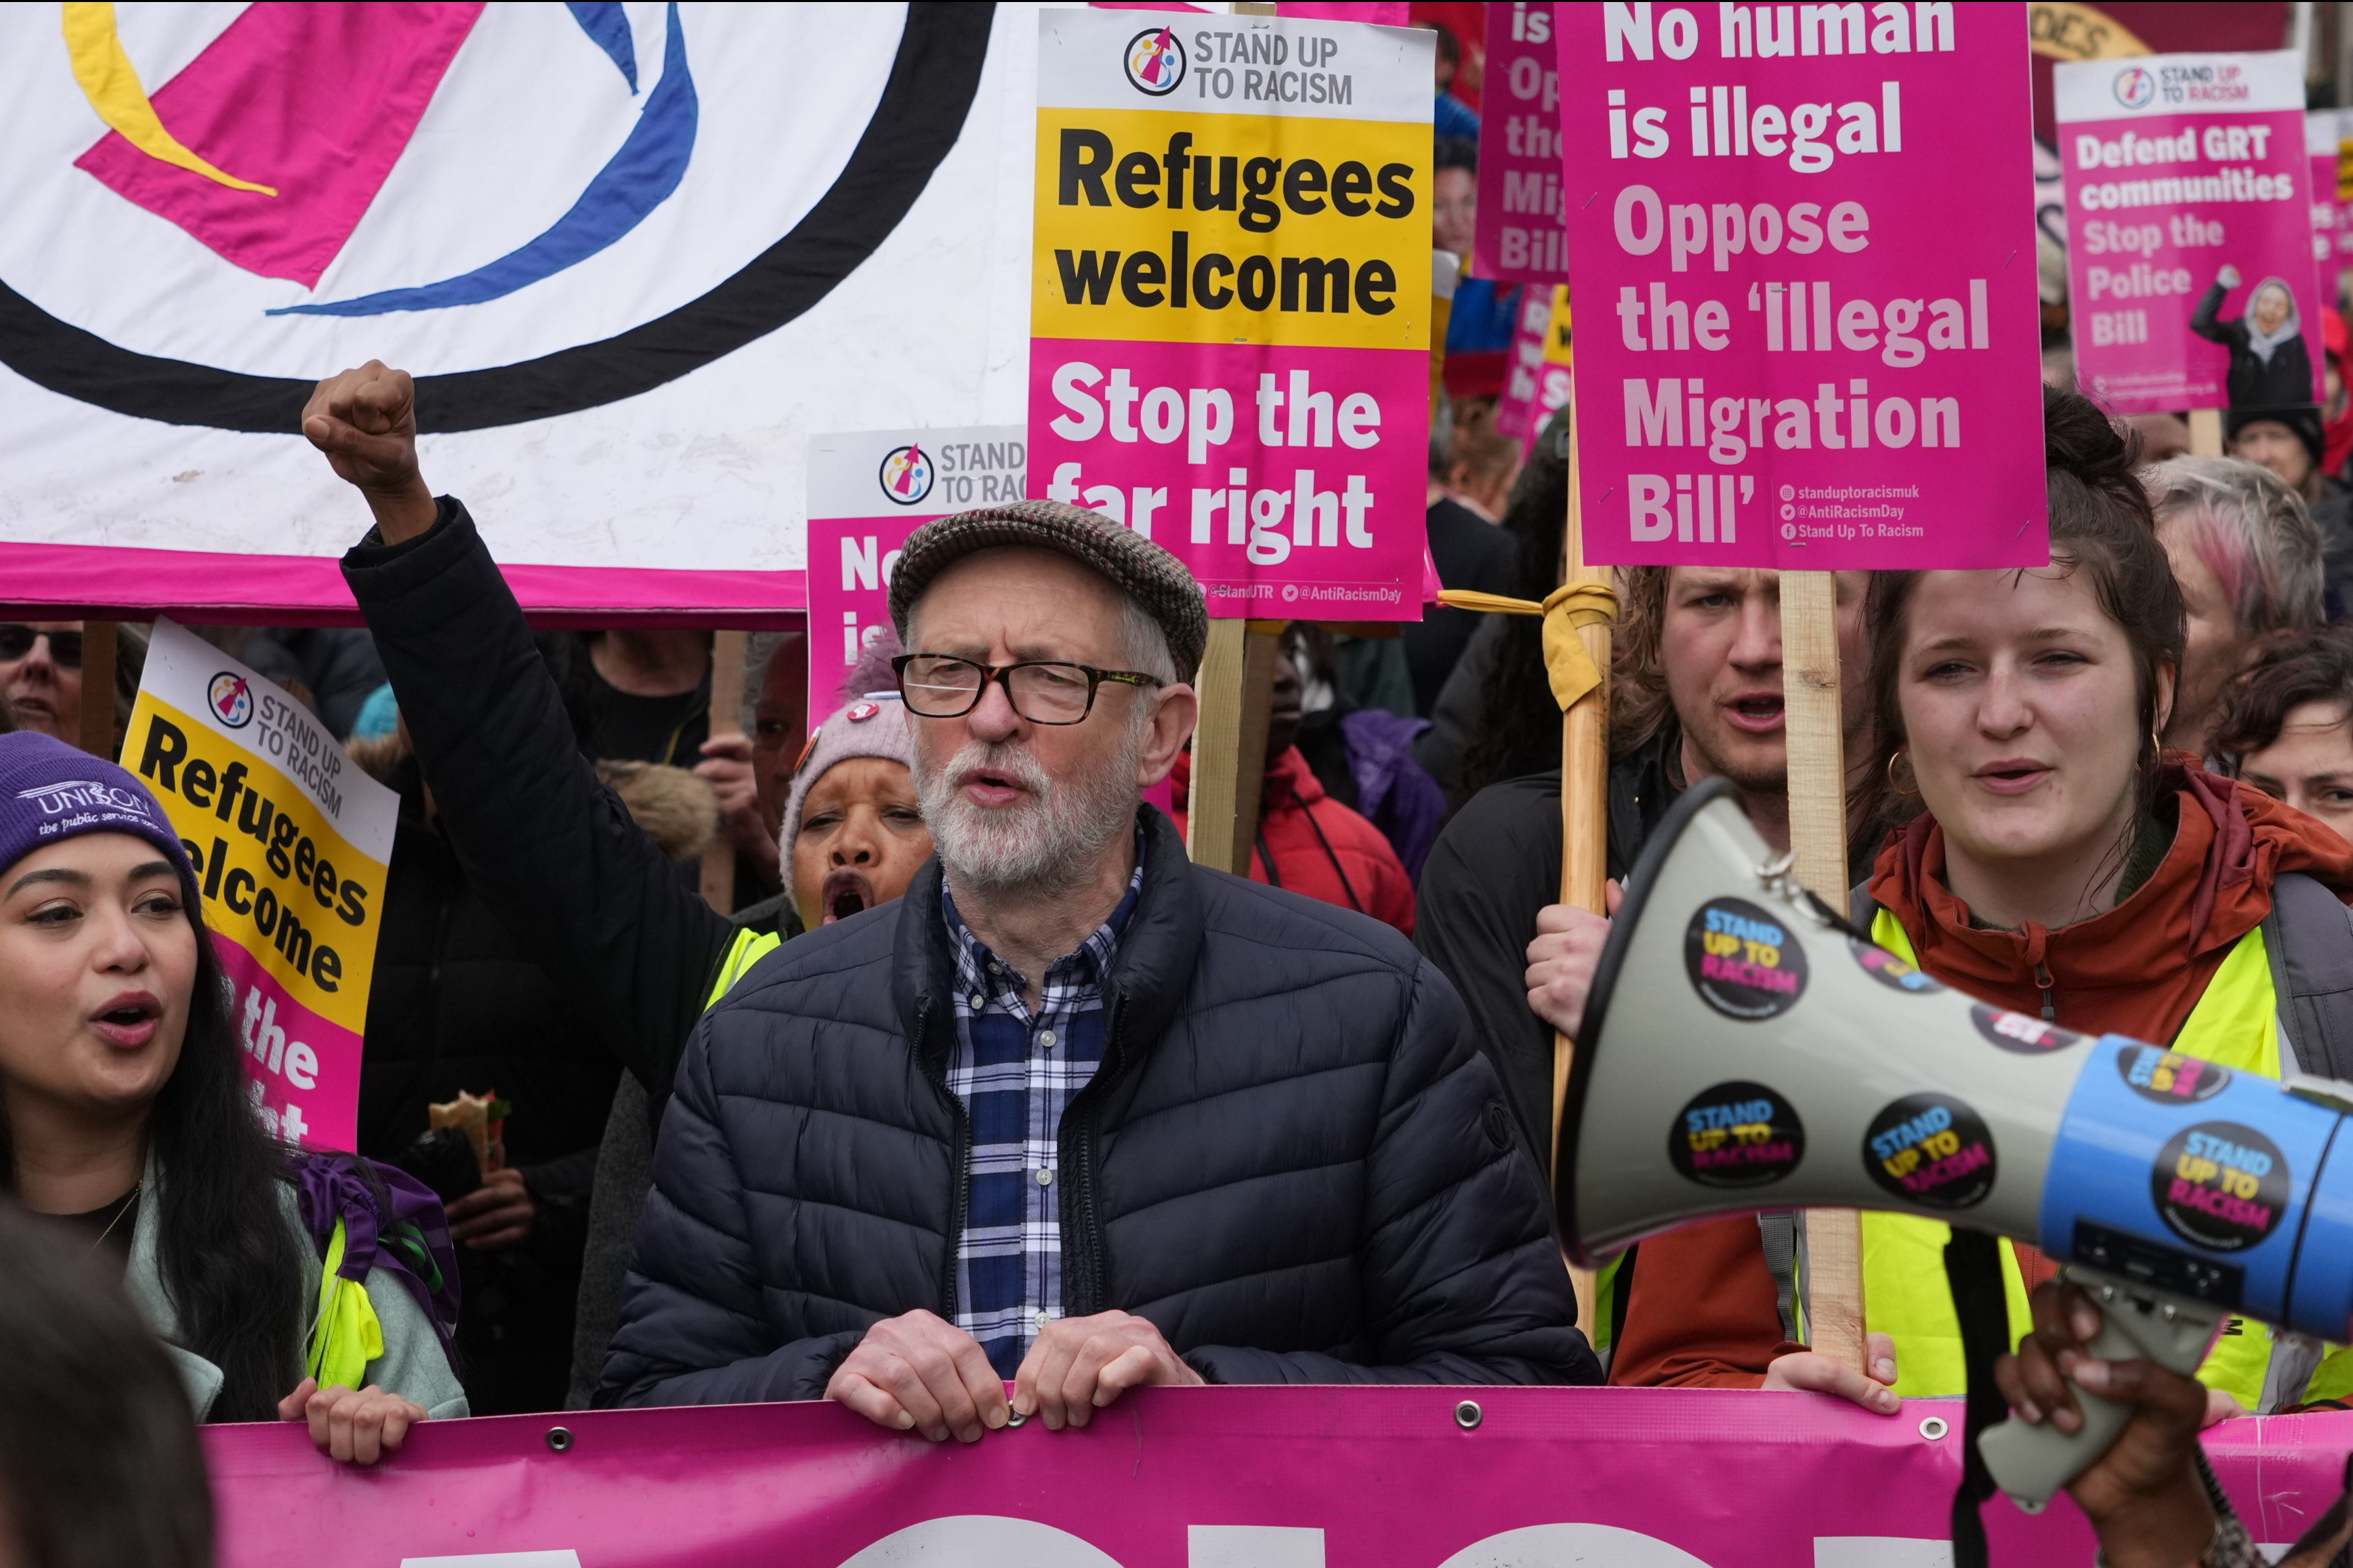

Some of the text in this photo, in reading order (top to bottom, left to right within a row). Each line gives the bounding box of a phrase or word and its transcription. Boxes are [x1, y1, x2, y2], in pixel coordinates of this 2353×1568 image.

[1512, 2, 1551, 44] is
[1604, 2, 1955, 62] No human
[1194, 30, 1337, 68] STAND UP
[1194, 68, 1352, 106] TO RACISM
[2161, 65, 2241, 85] STAND UP
[2163, 85, 2249, 103] TO RACISM
[1608, 81, 1902, 173] is illegal
[2076, 125, 2271, 169] Defend GRT
[1058, 128, 1415, 233] Refugees
[2079, 167, 2294, 211] communities
[1614, 184, 1870, 272] Oppose
[2083, 214, 2224, 258] Stop the
[1054, 230, 1396, 316] welcome
[2087, 262, 2192, 301] Police
[1617, 282, 1730, 351] the
[2090, 309, 2148, 347] Bill
[1049, 361, 1381, 465] Stop the
[1623, 379, 1961, 465] Migration
[941, 442, 1025, 472] STAND
[941, 475, 972, 503] TO
[1798, 485, 1919, 502] standuptoracismuk
[1190, 467, 1374, 566] right
[1797, 505, 1904, 520] @AntiRacismDay
[1799, 524, 1923, 541] Stand Up To Racism
[1208, 584, 1402, 605] @StandUTR @AntiRacismDay
[260, 695, 341, 776] STAND UP
[257, 720, 342, 820] TO RACISM
[39, 787, 150, 816] UNISON
[39, 822, 58, 835] the
[62, 811, 98, 832] public
[102, 811, 139, 823] service
[139, 714, 368, 926] Refugees
[1703, 930, 1781, 968] UP TO
[1705, 908, 1784, 947] STAND
[1702, 953, 1797, 994] RACISM
[241, 985, 318, 1090] the
[1687, 1099, 1774, 1132] STAND
[1688, 1122, 1771, 1151] UP TO
[1872, 1106, 1952, 1158] STAND
[1883, 1129, 1960, 1178] UP TO
[2185, 1131, 2272, 1177] STAND
[2177, 1153, 2260, 1200] UP TO
[2168, 1177, 2272, 1231] RACISM
